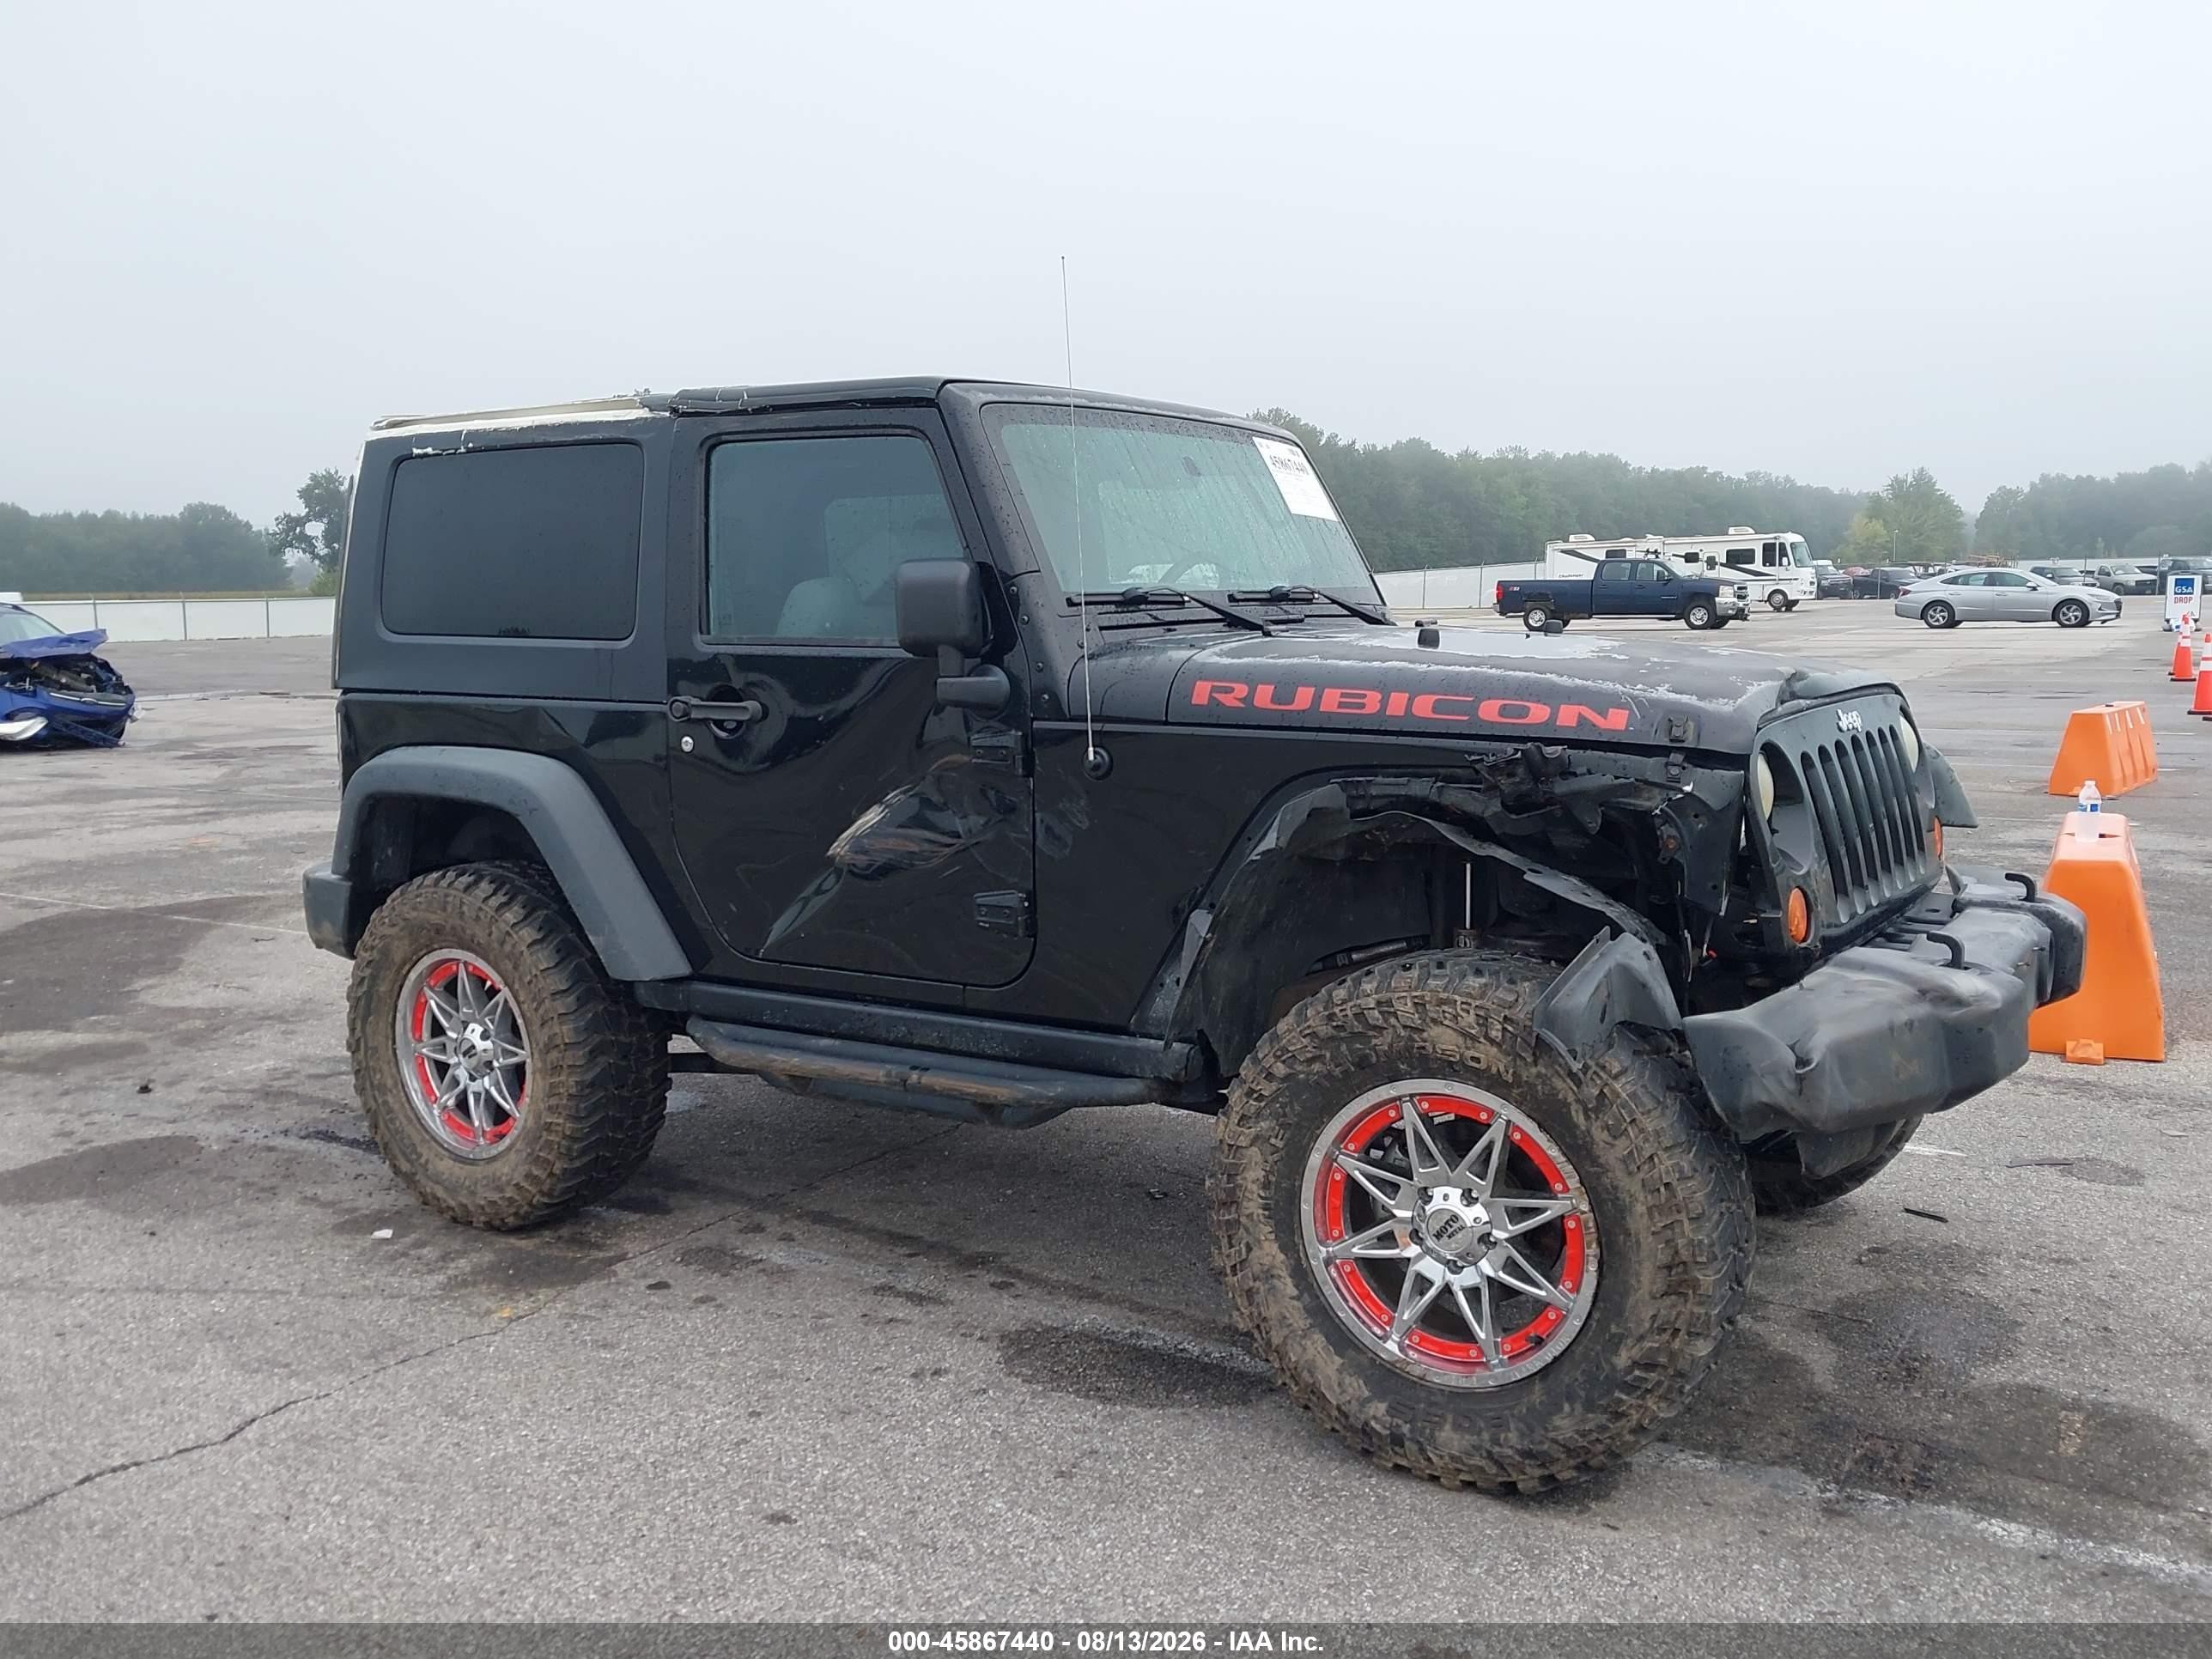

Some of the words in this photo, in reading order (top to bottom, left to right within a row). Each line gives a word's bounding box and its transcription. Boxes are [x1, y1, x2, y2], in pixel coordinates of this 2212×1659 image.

[2174, 596, 2193, 605] DROP
[1191, 680, 1629, 730] RUBICON
[1836, 708, 1863, 732] Jeep
[1432, 1214, 1459, 1242] MOTO
